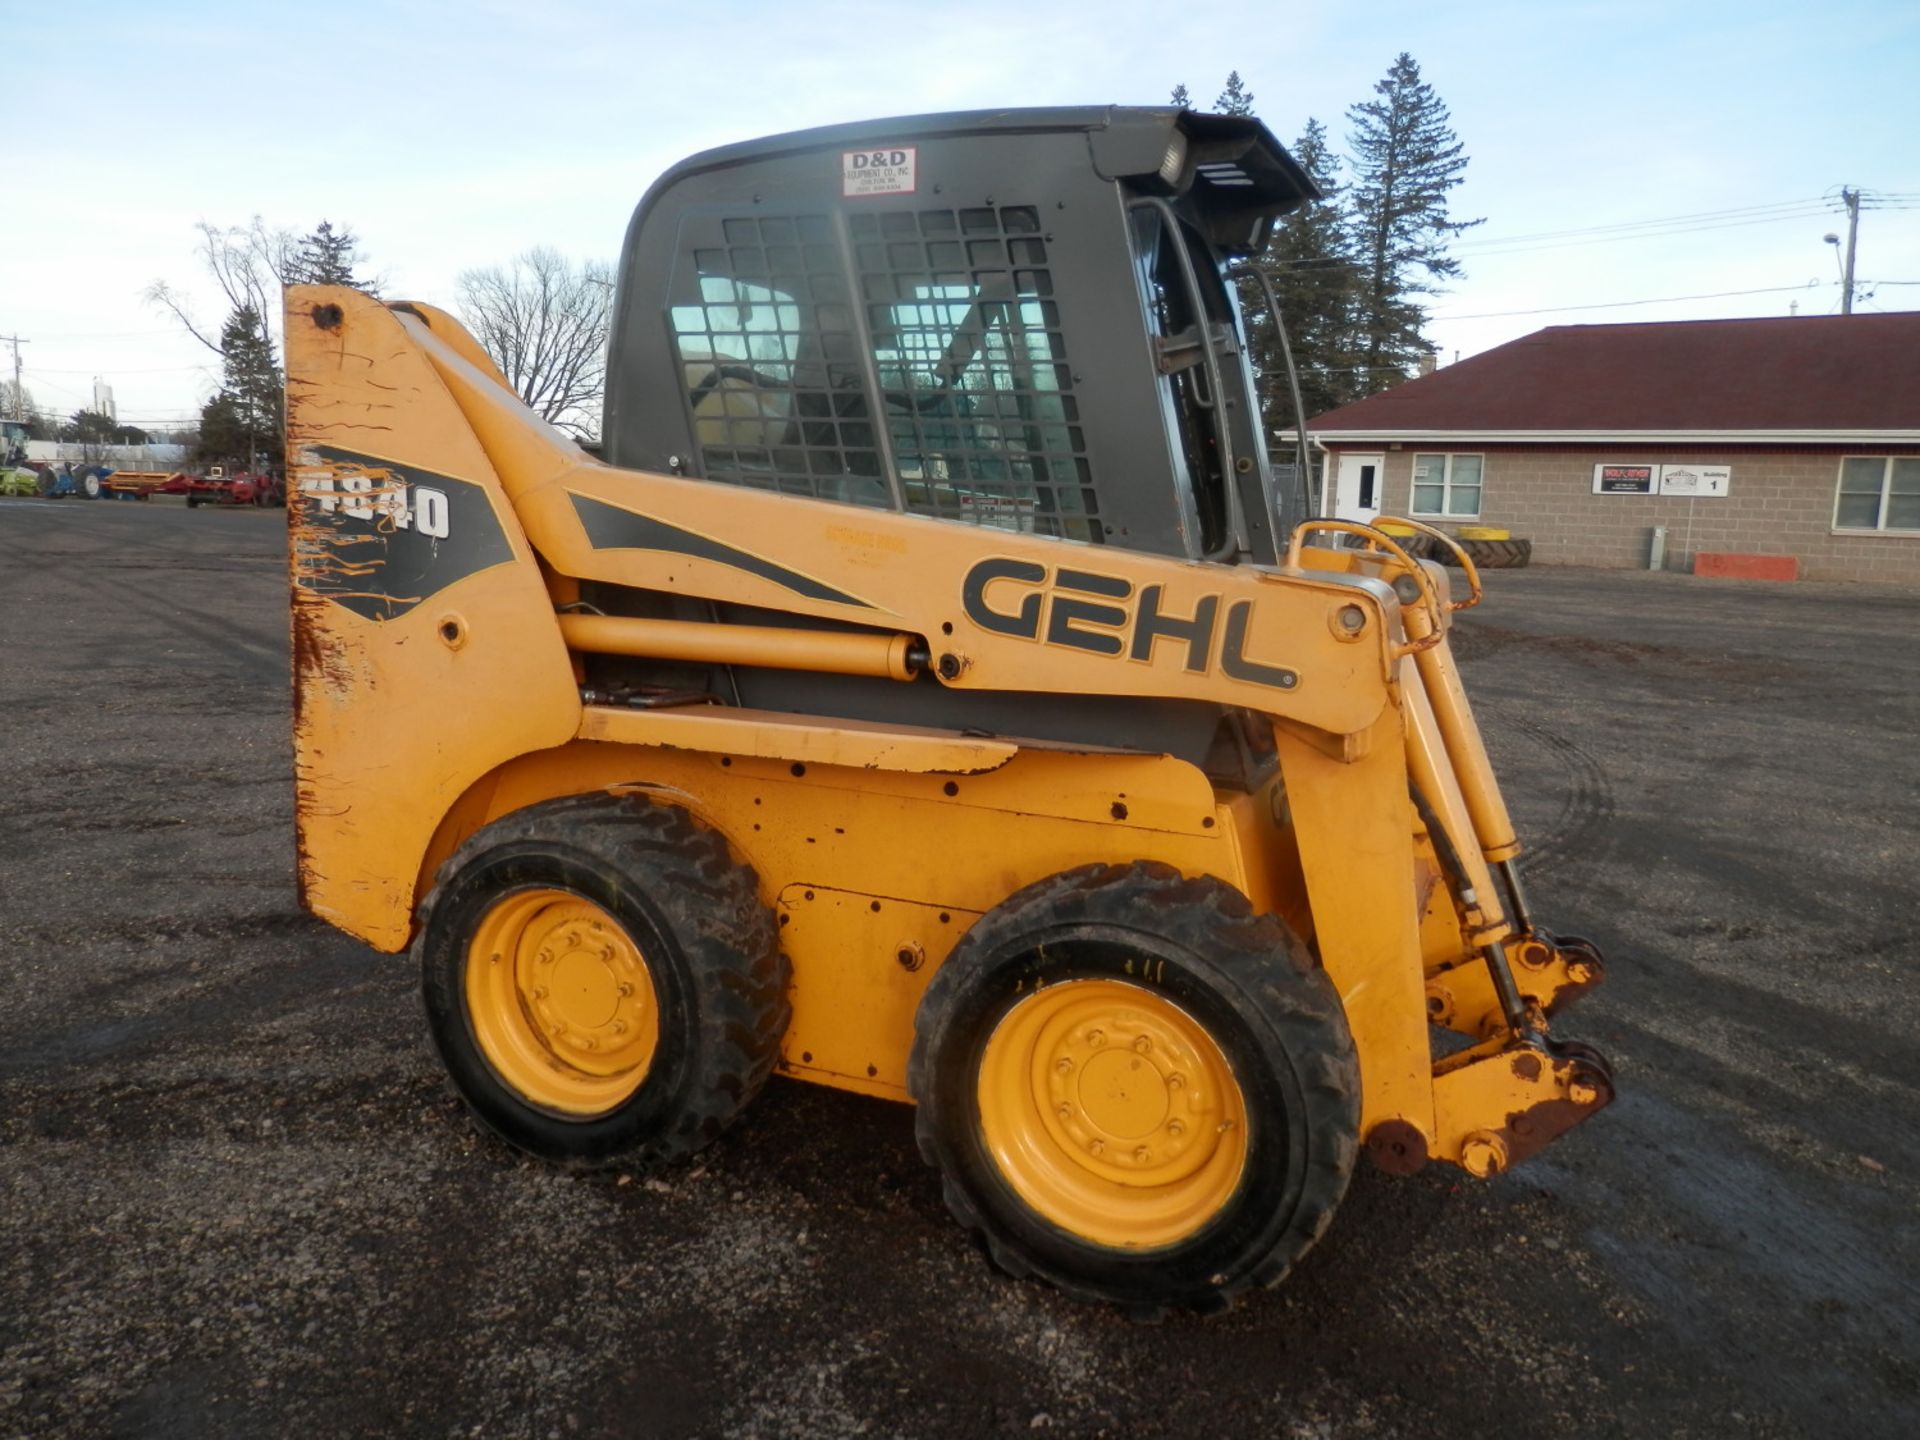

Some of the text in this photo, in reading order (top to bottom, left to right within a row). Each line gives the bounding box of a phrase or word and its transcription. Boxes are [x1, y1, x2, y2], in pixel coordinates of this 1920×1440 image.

[853, 151, 906, 169] D&D
[297, 468, 450, 540] 4840
[1710, 480, 1717, 490] 1
[963, 558, 1298, 689] GEHL
